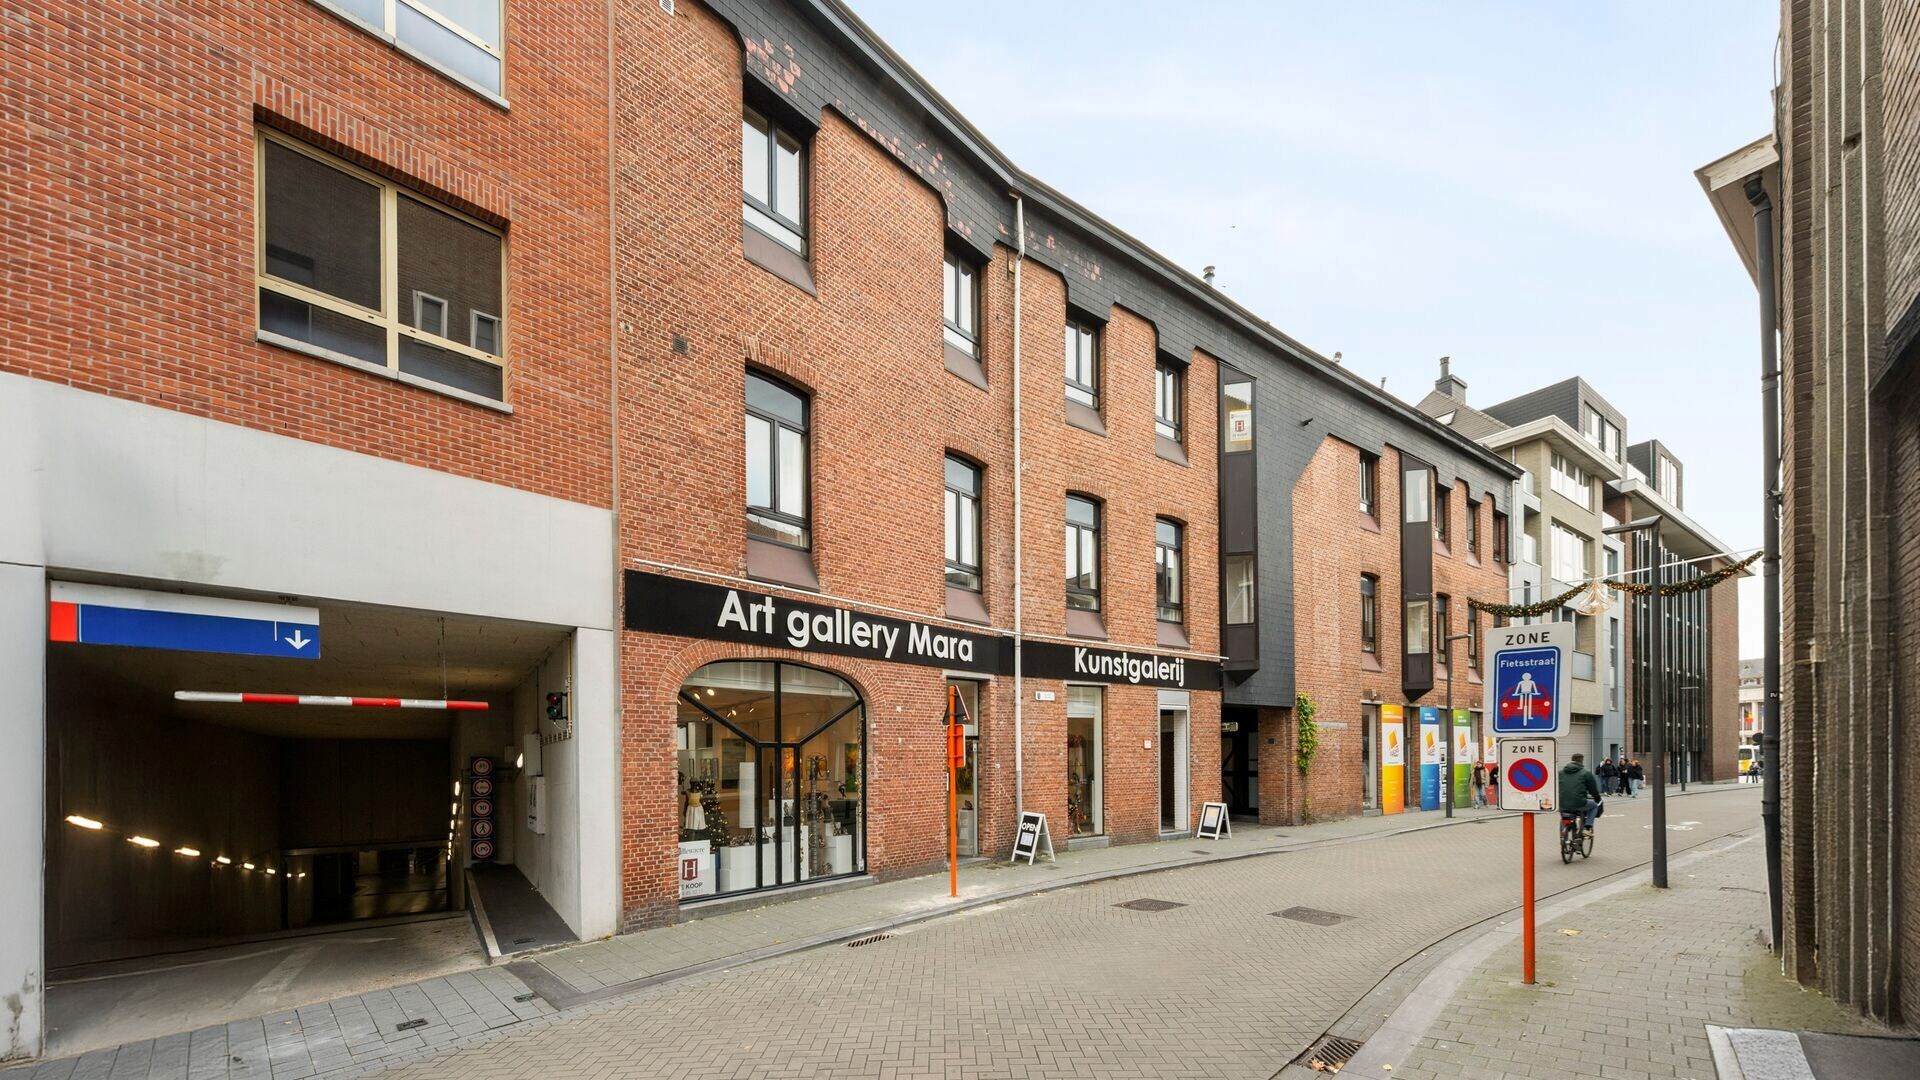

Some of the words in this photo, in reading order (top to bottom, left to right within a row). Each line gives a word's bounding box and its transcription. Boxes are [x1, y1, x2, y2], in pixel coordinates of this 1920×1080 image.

[717, 590, 775, 634] Art
[787, 608, 900, 659] gallery
[907, 623, 973, 662] Mara
[1505, 631, 1550, 646] ZONE
[1074, 647, 1185, 687] Kunstgalerij
[1500, 657, 1555, 668] Fietsstraat
[1512, 745, 1544, 753] ZONE
[684, 860, 696, 878] H
